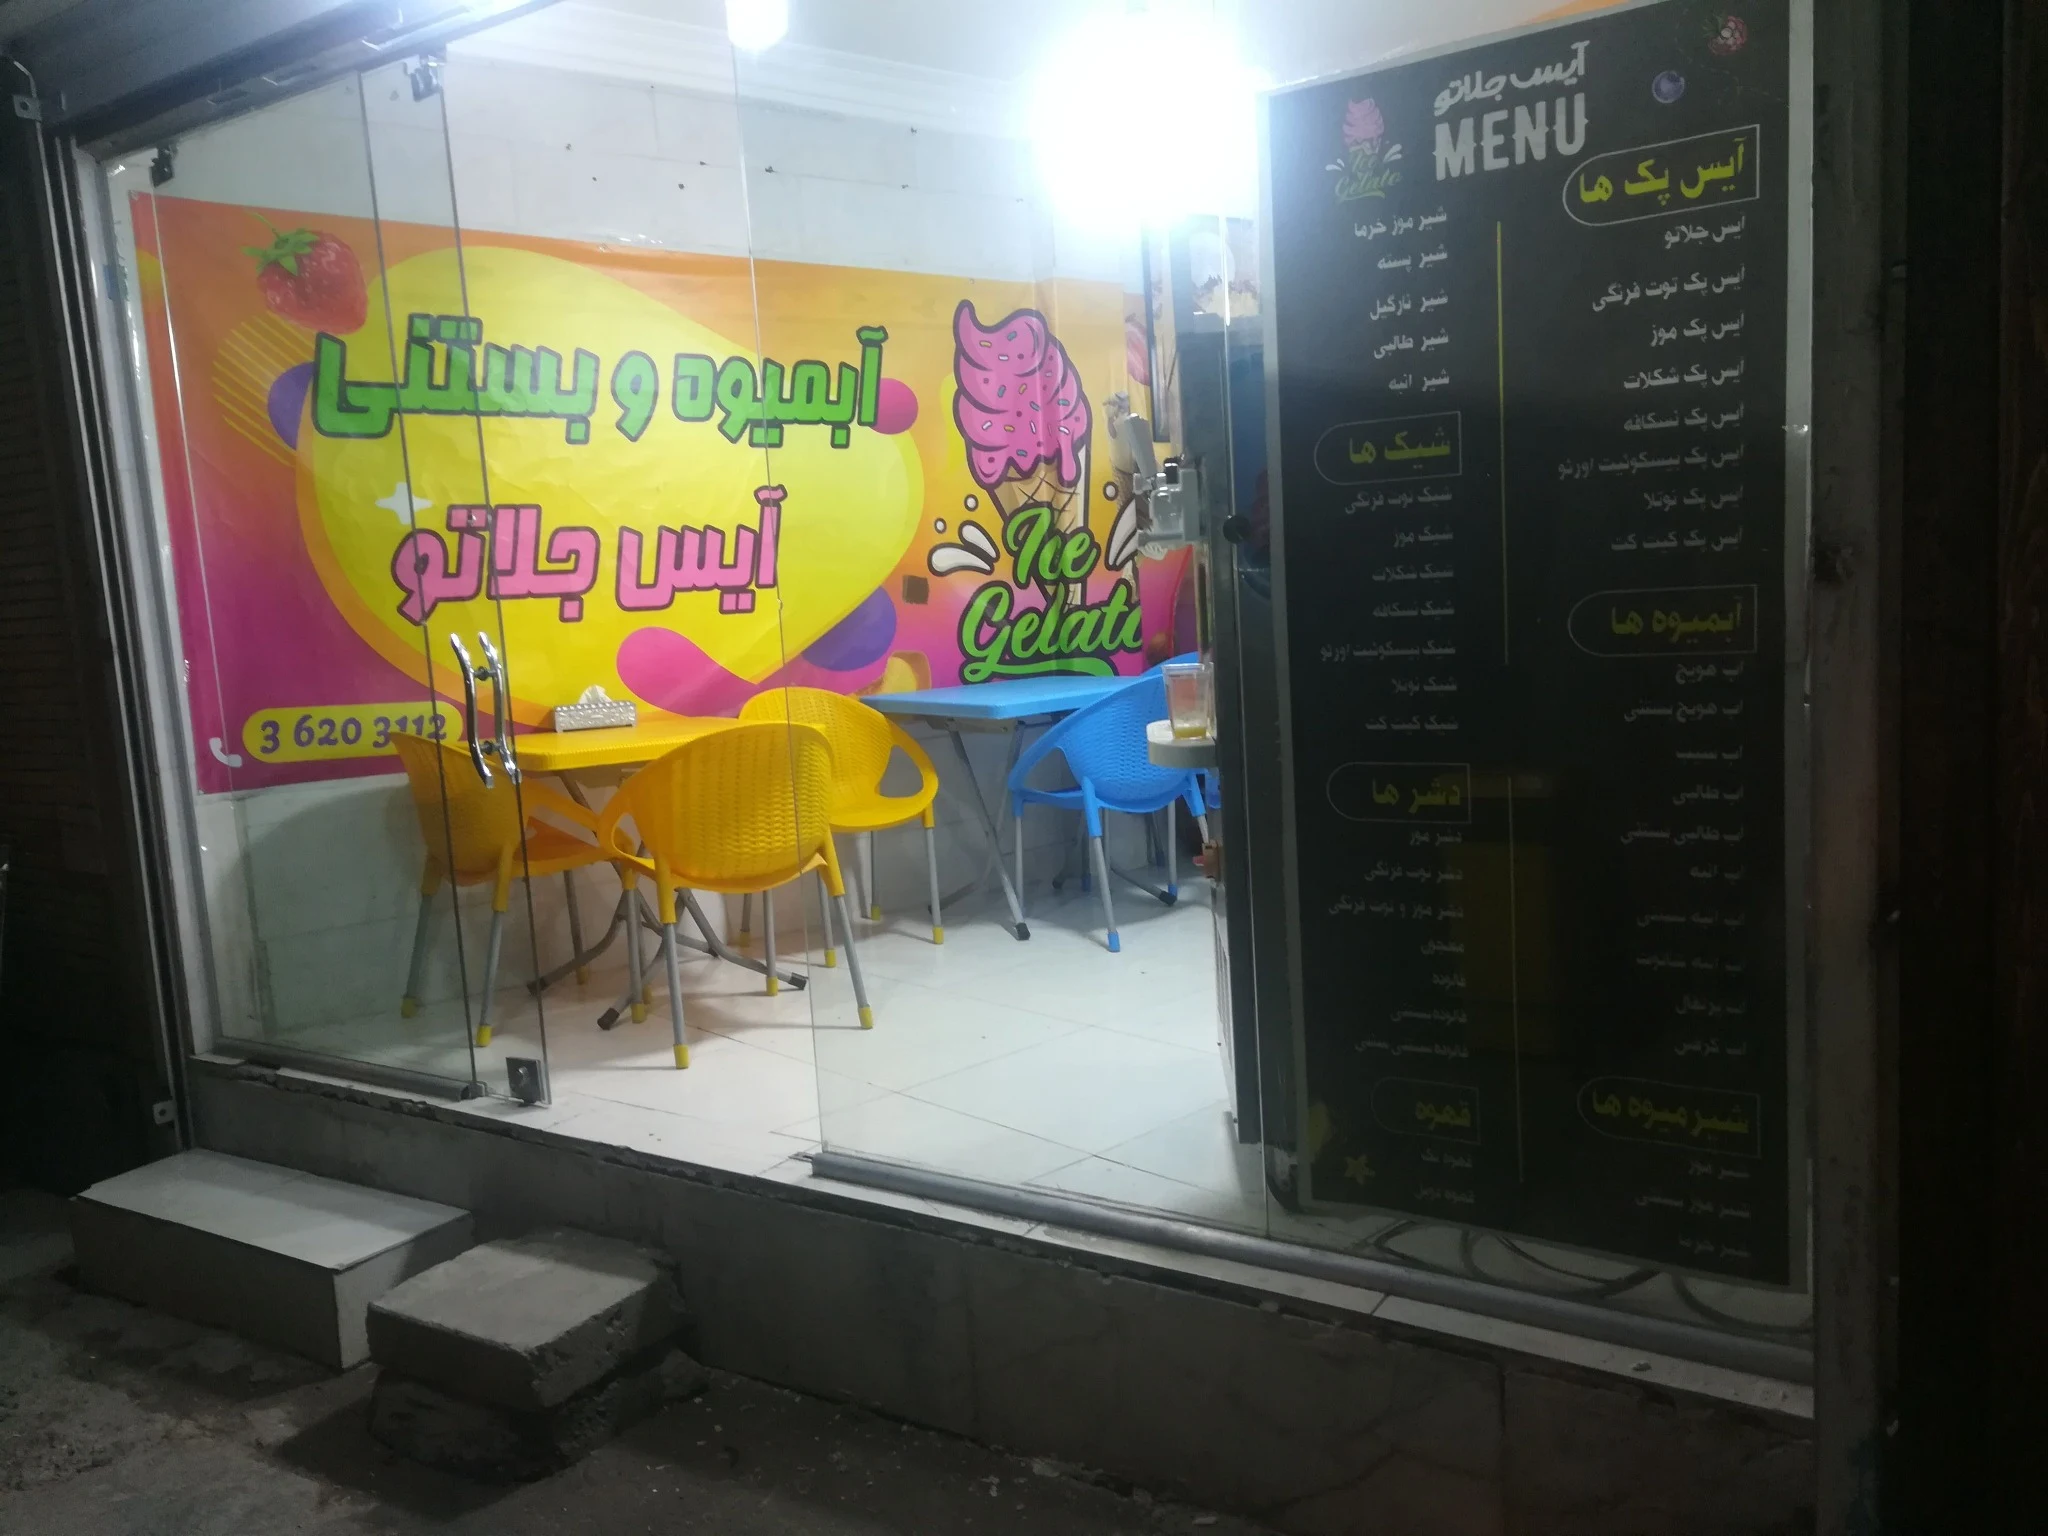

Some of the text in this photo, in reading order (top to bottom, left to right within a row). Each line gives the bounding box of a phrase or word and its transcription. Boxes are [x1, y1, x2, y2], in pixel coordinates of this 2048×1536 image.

[1434, 40, 1590, 117] آیس جلاتو
[1433, 92, 1591, 182] MENU
[1578, 137, 1747, 207] آیس پک ها
[1354, 206, 1448, 240] شیر موز خرما
[1664, 224, 1710, 250] جلاتو
[1377, 244, 1448, 273] شیر پسته
[1645, 276, 1679, 300] توت
[1683, 271, 1708, 297] پک
[1420, 288, 1449, 313] شیر
[1650, 323, 1678, 347] موز
[1683, 317, 1707, 344] پک
[1374, 328, 1450, 360] شیر طالبی
[312, 313, 889, 450] آبمیوه و بستنی
[1388, 368, 1450, 395] شیر انبه
[1623, 366, 1680, 391] شکلات
[1683, 364, 1707, 389] پک
[1623, 409, 1680, 432] نسکافه
[1684, 407, 1708, 432] پک
[1349, 426, 1451, 469] شیک ها
[1388, 490, 1414, 508] توت
[1418, 485, 1453, 507] شیک
[1643, 489, 1678, 513] نوتلا
[1004, 502, 1100, 588] Ice
[1393, 524, 1454, 549] شیک موز
[392, 484, 788, 627] آیس جلاتو
[1372, 562, 1455, 583] شیک شکلات
[1372, 600, 1456, 620] شیک نسکافه
[1610, 595, 1743, 645] آبمیوه ها
[1422, 639, 1457, 660] شیک
[1423, 676, 1459, 697] شیک
[1675, 663, 1718, 685] هویج
[1624, 698, 1673, 723] بستنی
[1675, 701, 1719, 723] هویج
[259, 713, 447, 754] 3 620 3112
[1371, 776, 1461, 814] دشر ها
[1672, 784, 1721, 807] طالبی
[1674, 824, 1721, 846] طالبی
[1592, 1088, 1622, 1118] ها
